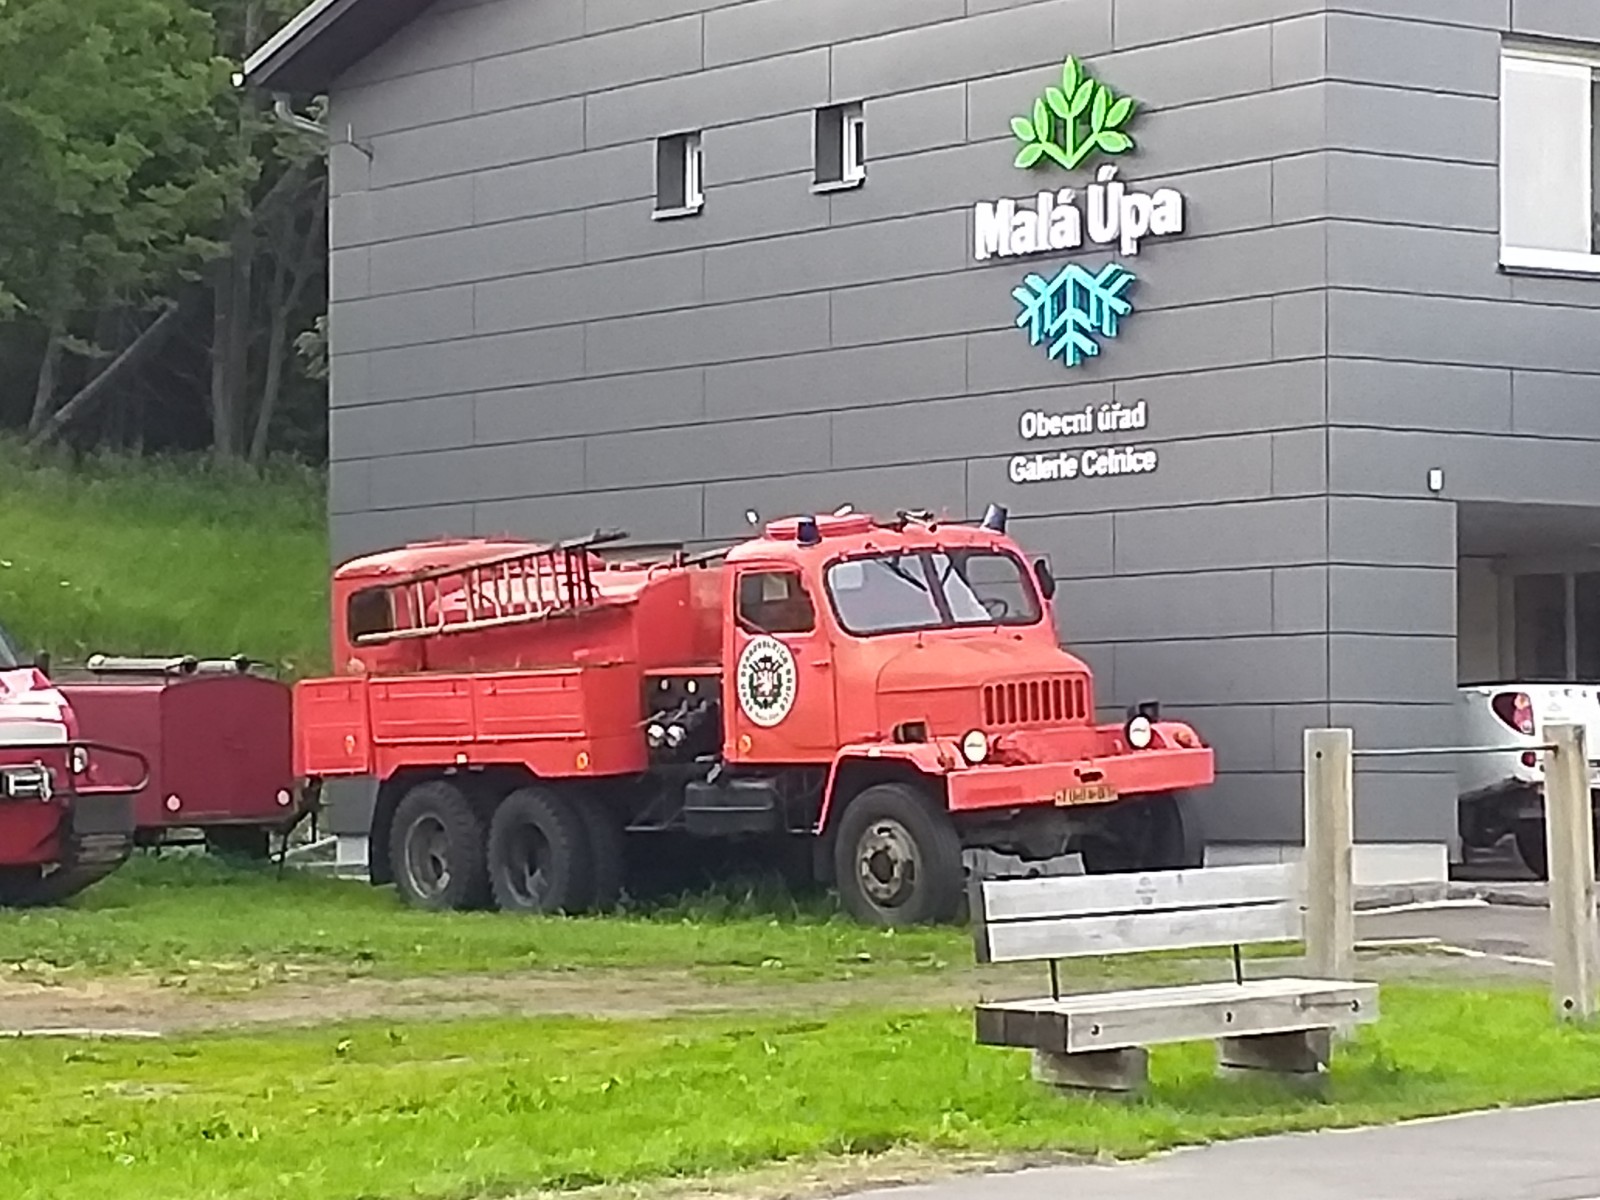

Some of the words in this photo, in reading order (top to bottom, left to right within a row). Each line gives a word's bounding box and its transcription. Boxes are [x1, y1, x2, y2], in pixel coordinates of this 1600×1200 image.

[974, 188, 1082, 260] Malá
[1087, 164, 1184, 256] Úpa
[1020, 406, 1093, 439] Obecní
[1097, 400, 1147, 433] úřad
[1009, 452, 1079, 483] Galerie
[1081, 446, 1157, 478] Celnice
